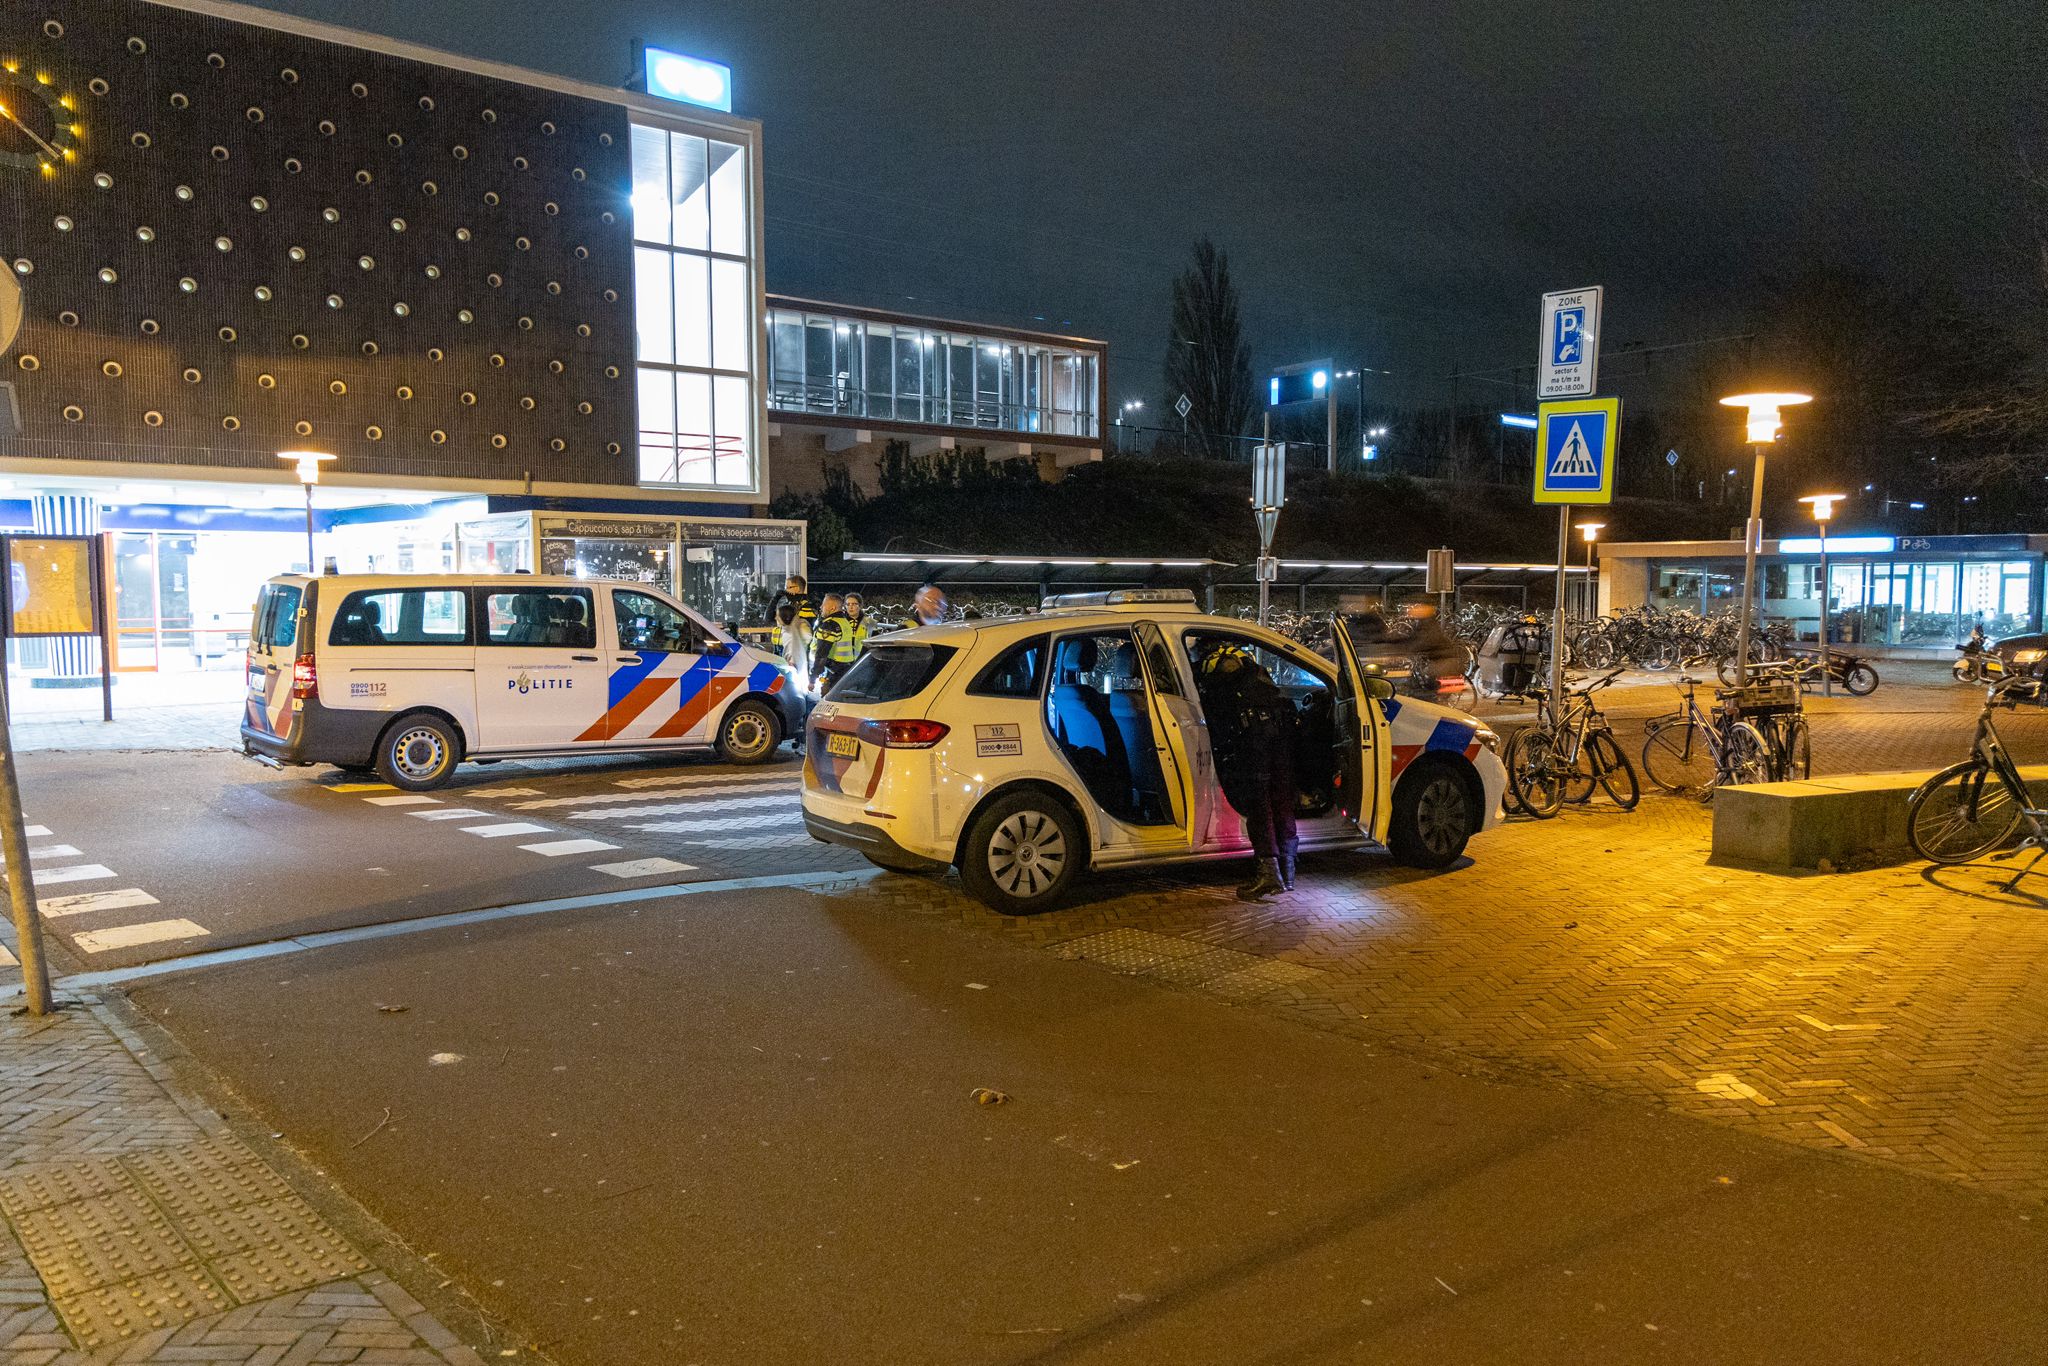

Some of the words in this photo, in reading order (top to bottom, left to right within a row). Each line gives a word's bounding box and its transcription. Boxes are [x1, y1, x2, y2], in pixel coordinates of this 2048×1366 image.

[1558, 295, 1583, 307] ZONE
[1560, 313, 1577, 343] P
[1554, 367, 1573, 375] sector
[1561, 375, 1572, 383] t/m
[1545, 383, 1585, 392] 09.00-18.00h
[568, 521, 620, 535] Cappuccino's,
[621, 526, 635, 536] sap
[636, 525, 642, 534] &
[643, 525, 654, 534] fris
[700, 526, 726, 538] Panini's,
[727, 529, 753, 538] soepen
[753, 529, 759, 537] &
[759, 528, 784, 538] salades
[1902, 539, 1911, 550] P
[369, 683, 387, 691] 112
[508, 679, 573, 694] POLITIE
[991, 727, 1004, 735] 112
